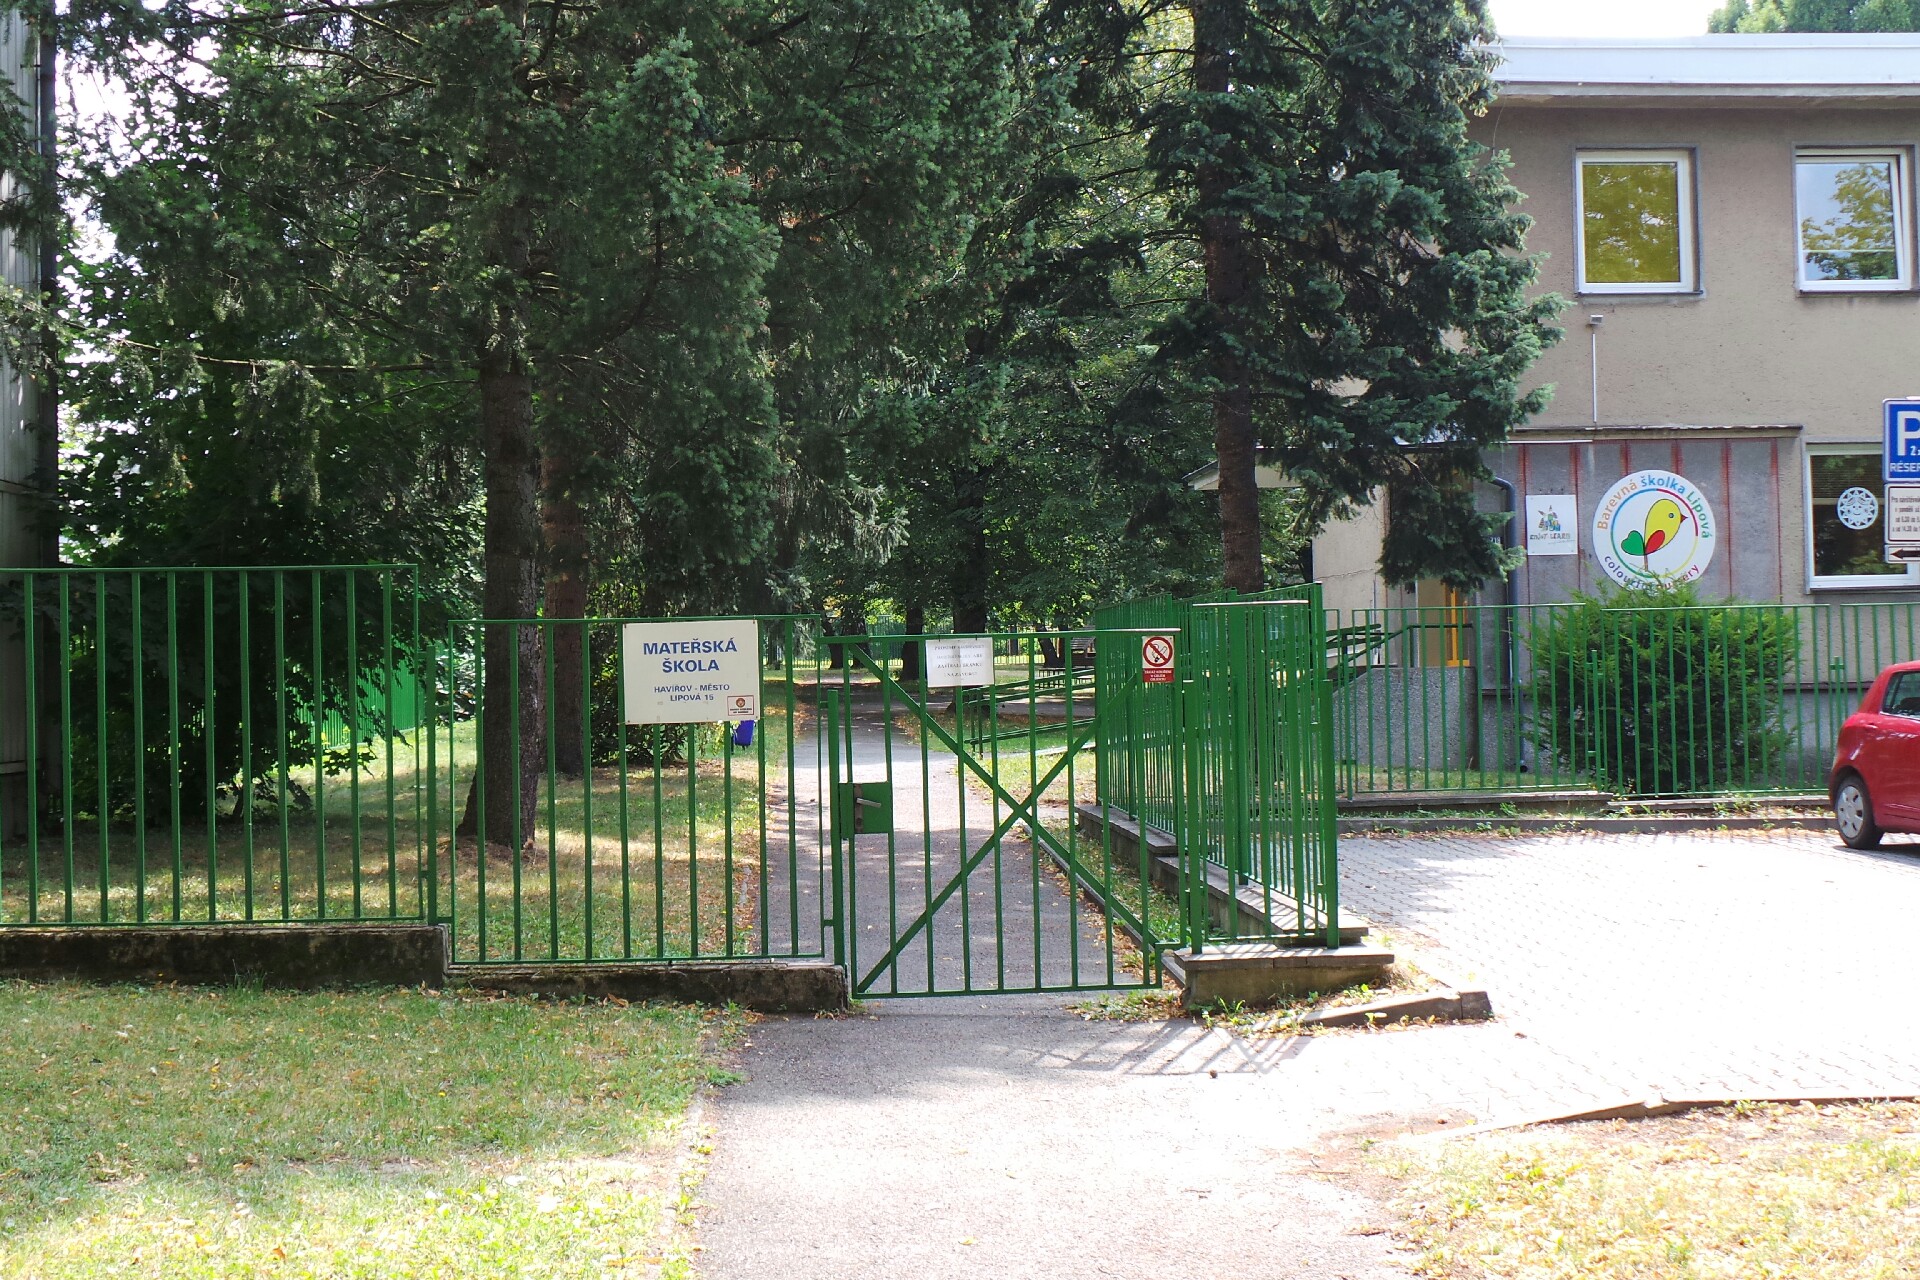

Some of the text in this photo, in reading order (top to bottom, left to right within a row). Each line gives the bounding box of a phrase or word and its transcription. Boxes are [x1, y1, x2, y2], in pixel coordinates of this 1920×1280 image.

[1897, 410, 1920, 456] P
[1596, 475, 1713, 540] Barevná školka Lipová
[643, 637, 738, 655] MATEŘSKÁ
[662, 658, 720, 673] ŠKOLA
[699, 683, 730, 692] MĚSTO
[670, 693, 702, 702] LIPOVÁ
